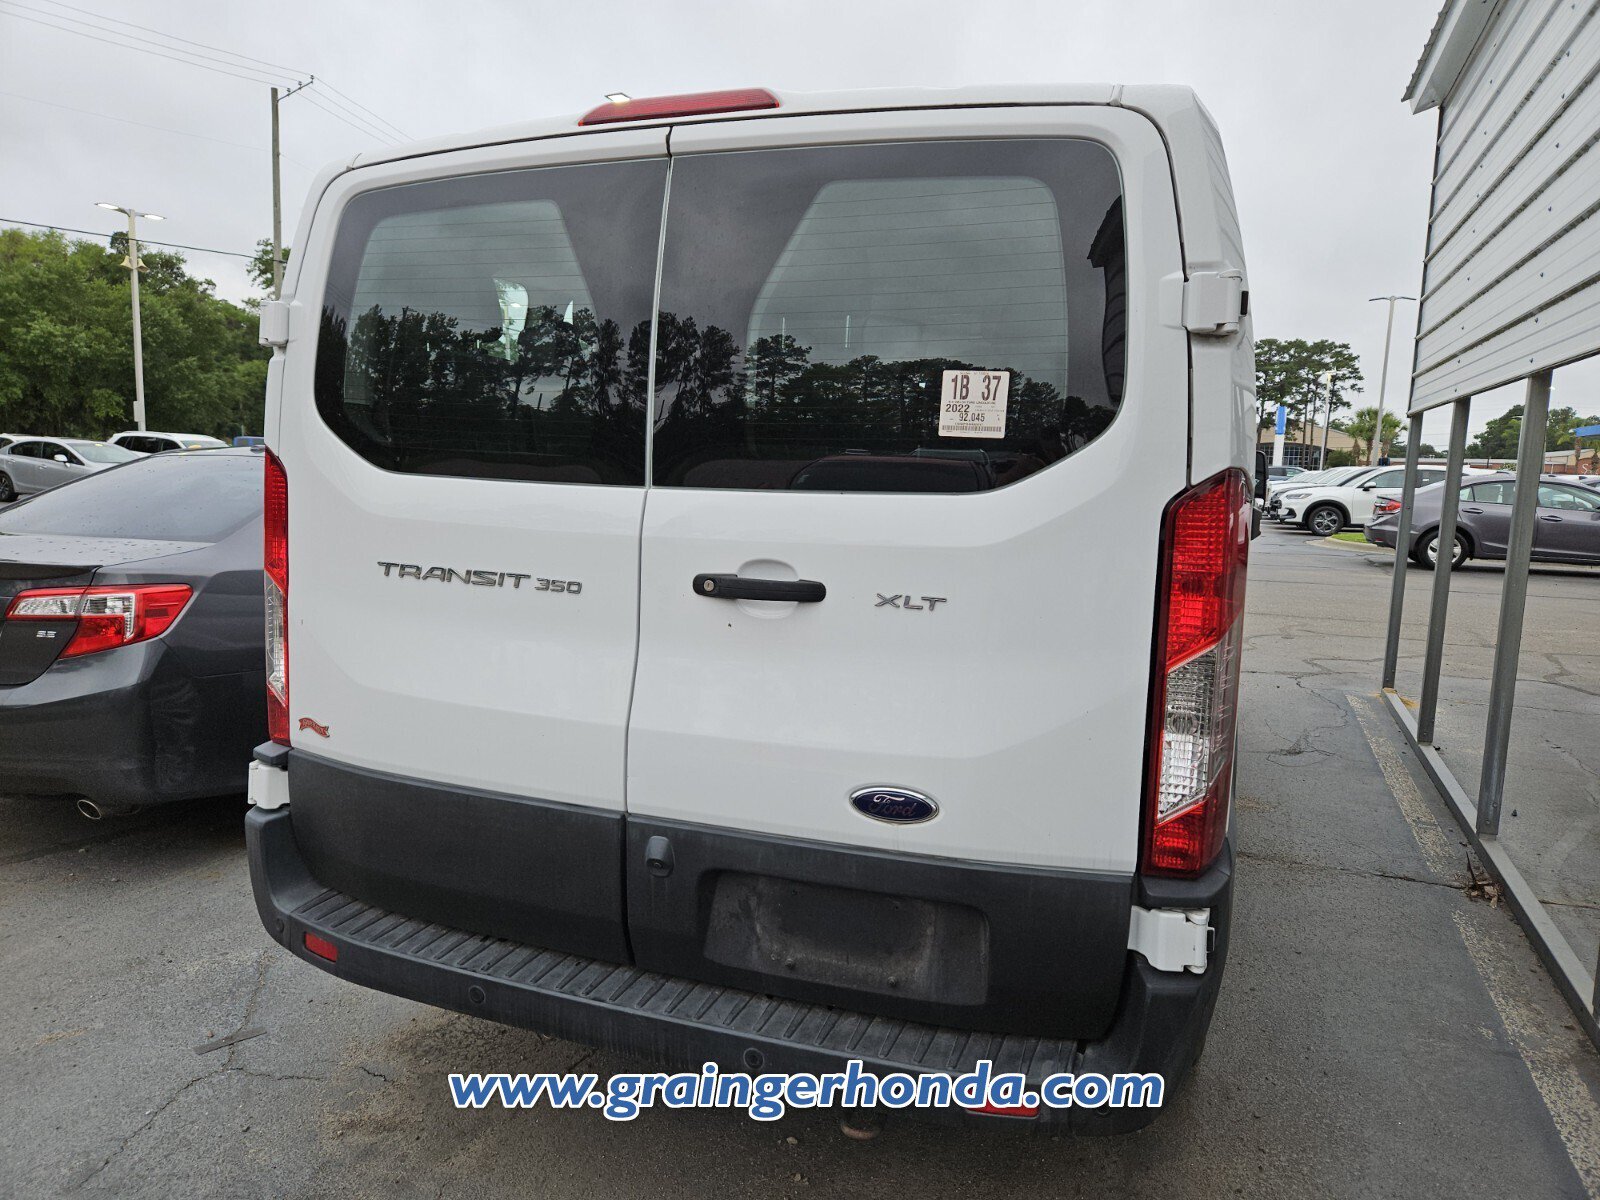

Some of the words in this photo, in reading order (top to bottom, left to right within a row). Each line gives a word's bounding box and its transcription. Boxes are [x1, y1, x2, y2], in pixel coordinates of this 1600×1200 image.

[951, 374, 970, 400] 1B
[981, 374, 1002, 401] 37
[945, 403, 970, 413] 2022
[377, 561, 531, 588] TRANSIT
[534, 577, 583, 594] 350
[874, 593, 948, 611] XLT
[869, 794, 918, 817] Ford
